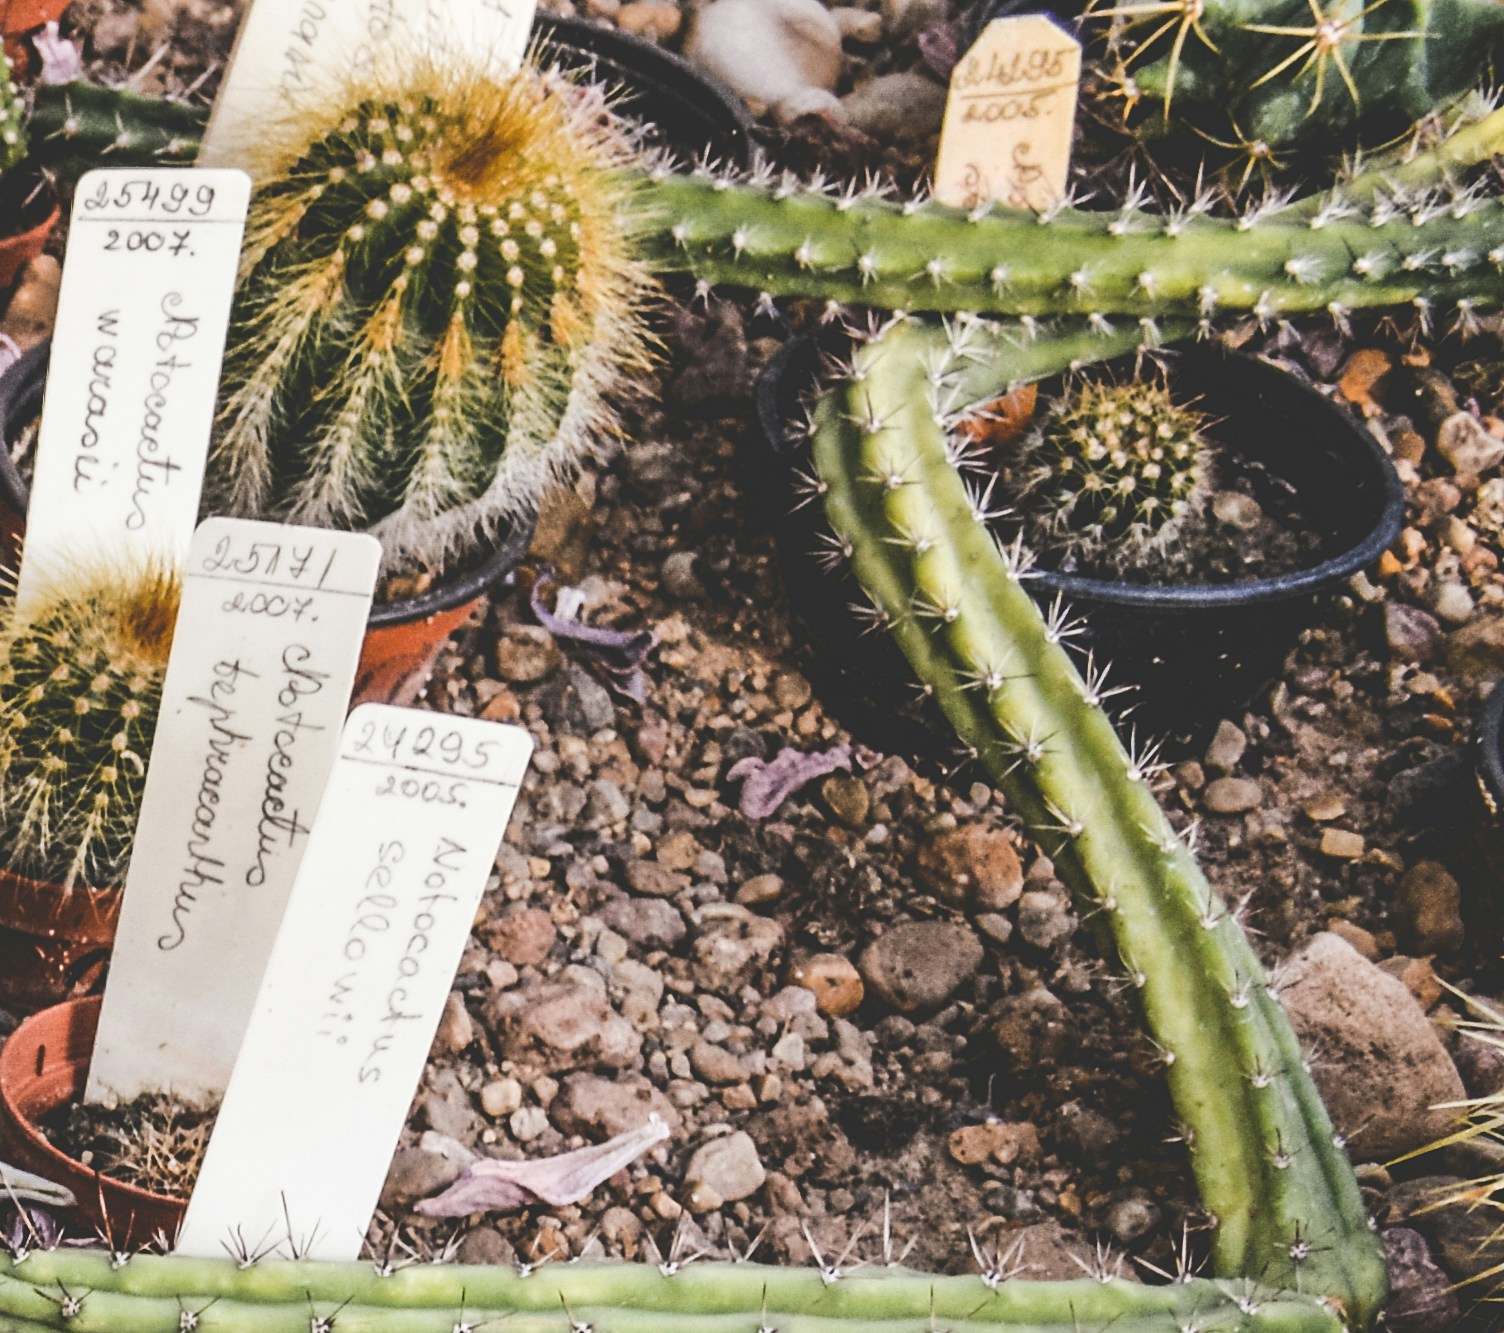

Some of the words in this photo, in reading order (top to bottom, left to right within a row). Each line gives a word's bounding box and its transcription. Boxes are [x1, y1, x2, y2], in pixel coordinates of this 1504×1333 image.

[81, 181, 217, 217] 25499
[67, 309, 125, 496] warasii
[122, 290, 201, 532] Notocactus
[158, 658, 254, 952] tephracanthus
[242, 642, 331, 889] Notocactus
[351, 722, 501, 772] 24295
[314, 839, 408, 1046] sellowii
[358, 837, 471, 1087] Notocactus
